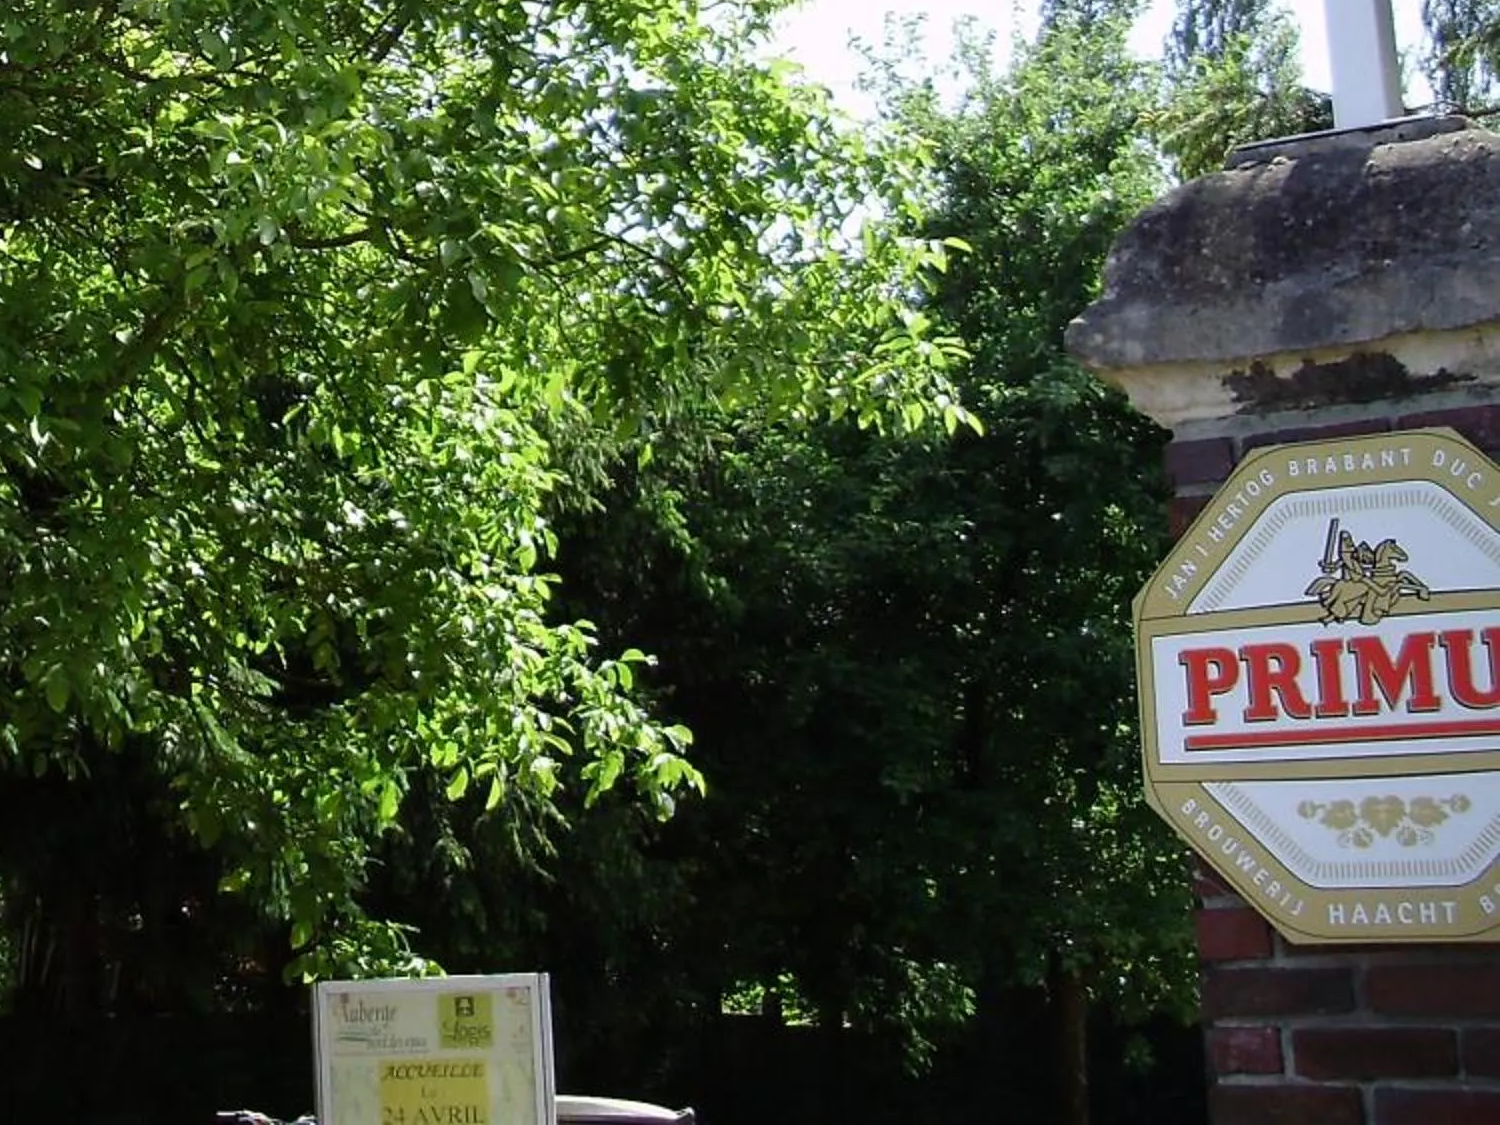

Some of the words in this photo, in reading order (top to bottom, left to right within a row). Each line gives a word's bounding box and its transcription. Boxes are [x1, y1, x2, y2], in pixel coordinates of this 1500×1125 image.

[1208, 469, 1274, 543] HERTOG
[1288, 448, 1412, 477] BRABANT
[1432, 449, 1482, 491] DUC
[1181, 798, 1305, 916] BROUWERIJ
[1328, 902, 1457, 925] HAACHT
[412, 1105, 485, 1124] AVRIL
